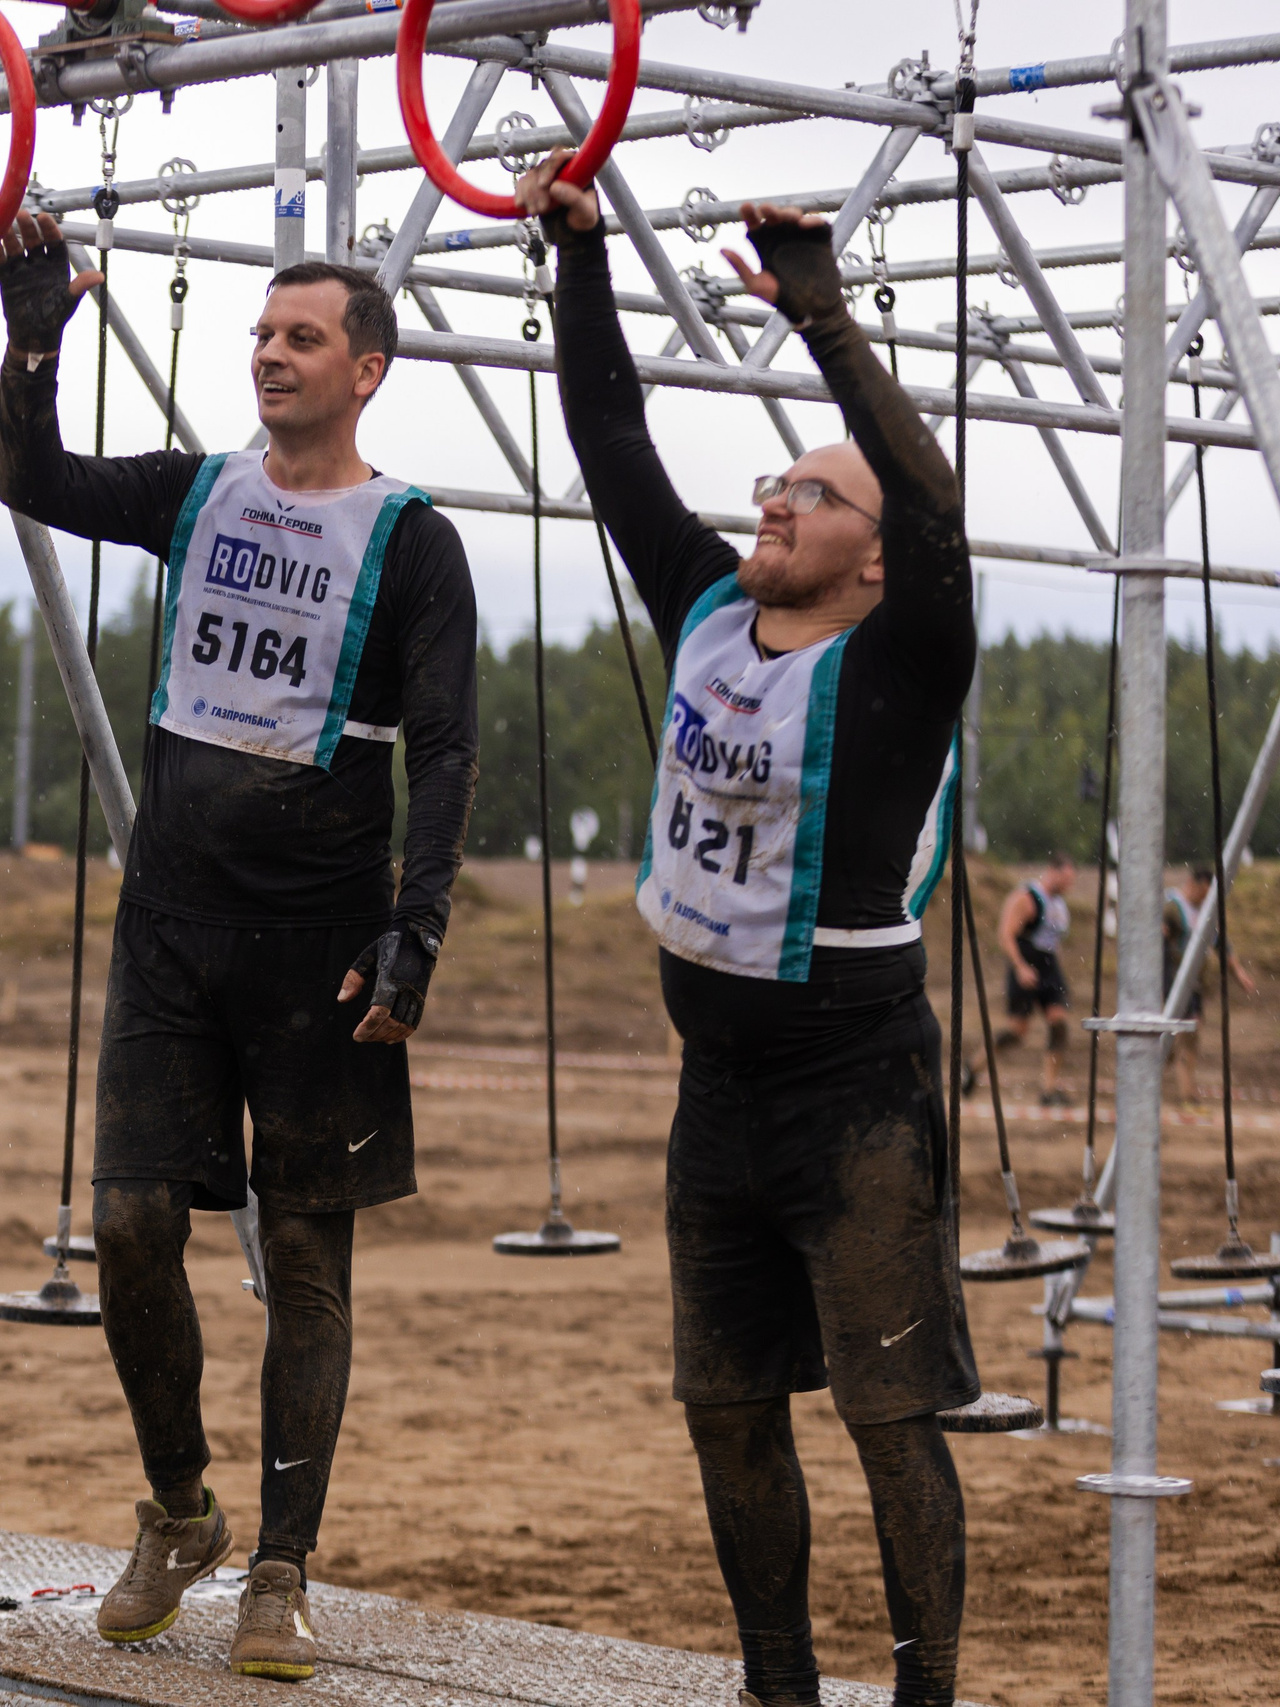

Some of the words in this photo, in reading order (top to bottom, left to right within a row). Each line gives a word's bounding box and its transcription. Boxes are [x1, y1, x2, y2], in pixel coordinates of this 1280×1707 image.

[242, 508, 276, 524] ГОНКА
[277, 515, 323, 534] ГЕРОЕВ
[211, 541, 332, 604] RODVIG
[192, 612, 308, 688] 5164
[211, 706, 278, 730] ГАЗПРОМБАНК
[668, 791, 754, 885] 621
